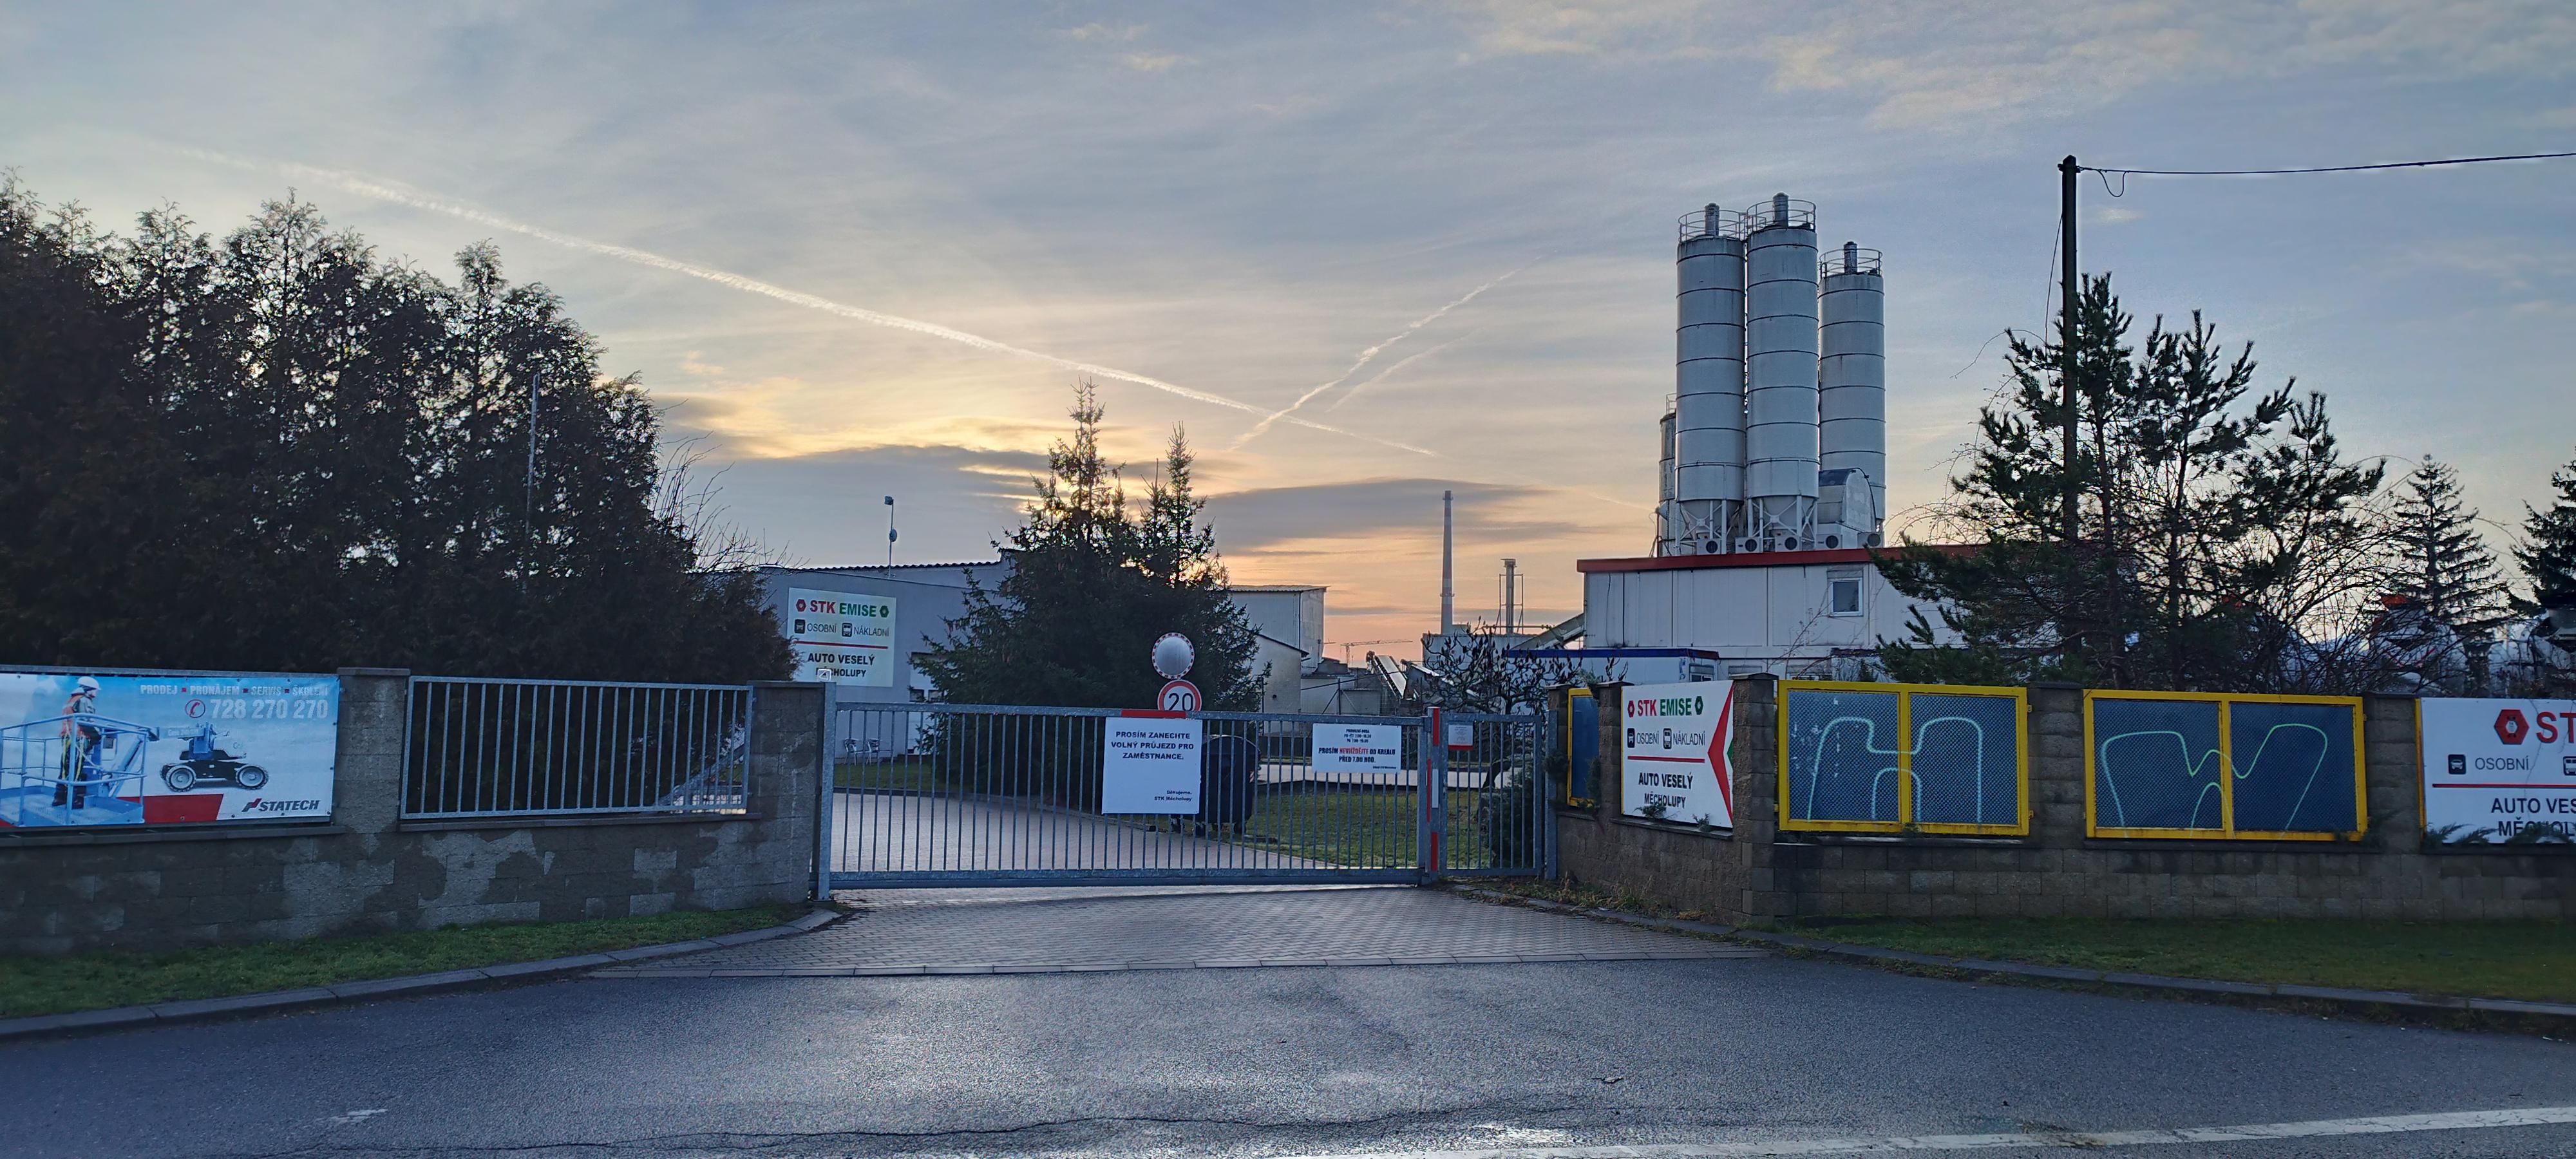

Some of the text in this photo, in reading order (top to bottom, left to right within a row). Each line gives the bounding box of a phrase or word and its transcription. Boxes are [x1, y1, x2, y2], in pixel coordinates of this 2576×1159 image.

[810, 600, 876, 617] STK EMISE
[807, 623, 889, 637] OSOBNÍ NÁKLADNÍ
[808, 653, 875, 665] AUTO VESELÝ
[140, 684, 178, 695] PRODEJ
[189, 684, 240, 695] PRONÁJEM
[251, 685, 281, 696] SERVIS
[209, 699, 328, 719] 728 270 270
[1168, 693, 1193, 710] 20
[1637, 698, 1692, 716] STK EMISE
[2536, 711, 2576, 744] ST
[1636, 730, 1705, 746] OSOBNÍ NÁKLADNÍ
[2475, 755, 2529, 770] OSOBNÍ
[1638, 771, 1694, 789] AUTO VESELÝ
[258, 800, 319, 811] STATECH
[2491, 798, 2541, 813] AUTO
